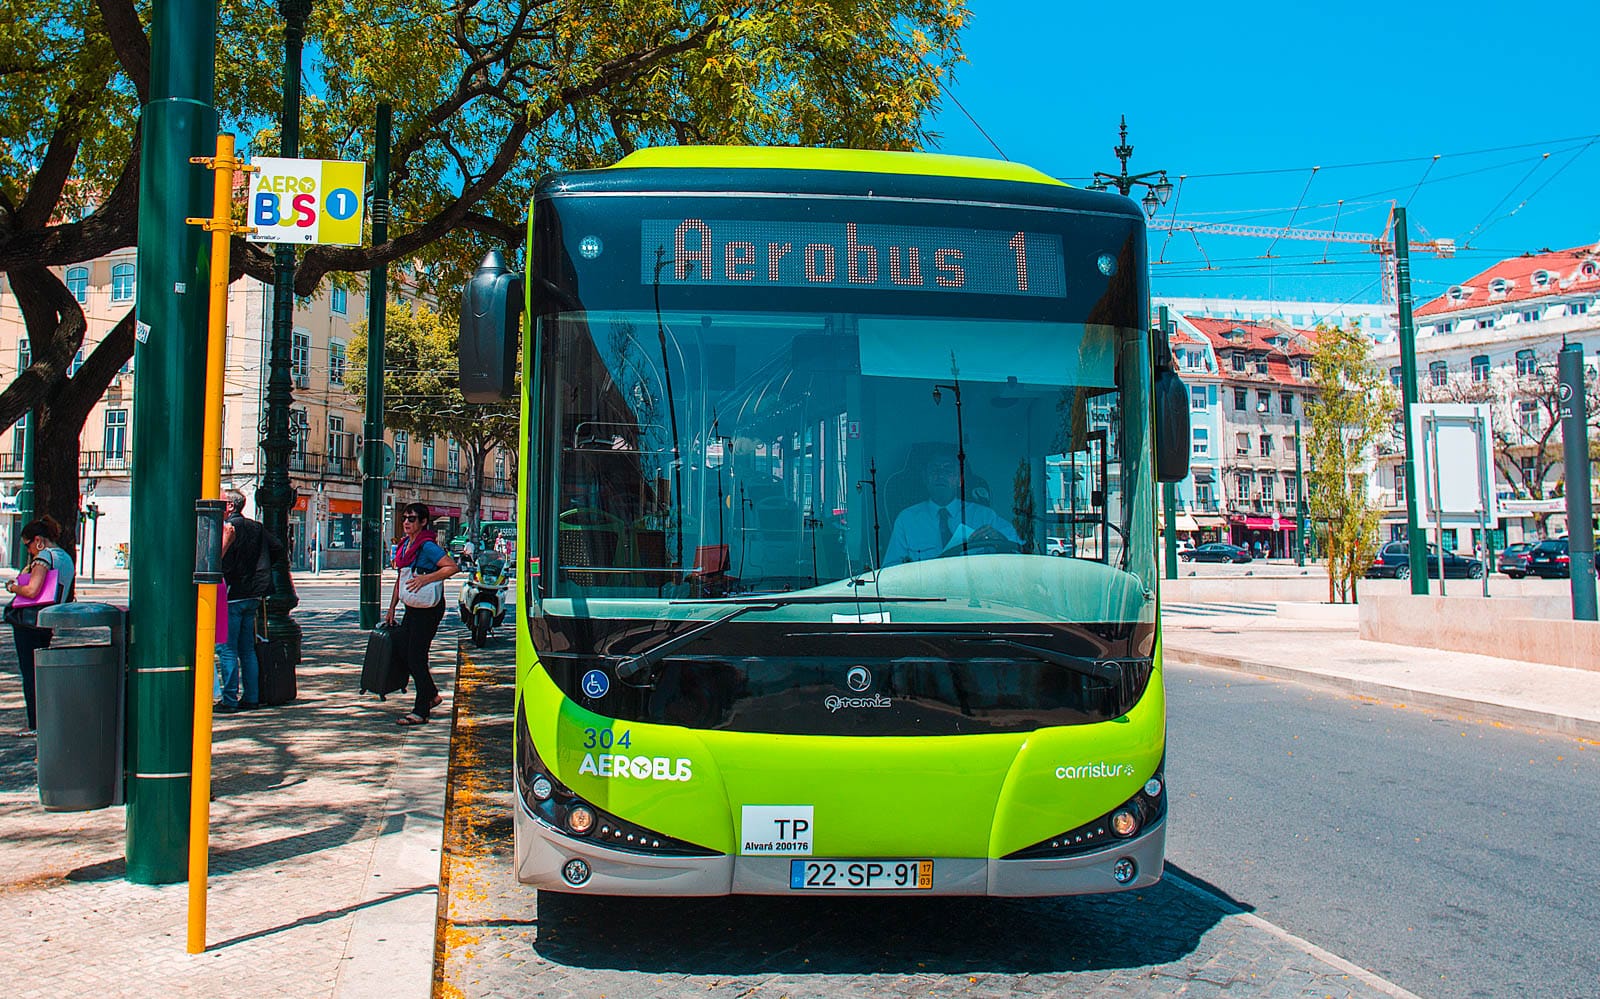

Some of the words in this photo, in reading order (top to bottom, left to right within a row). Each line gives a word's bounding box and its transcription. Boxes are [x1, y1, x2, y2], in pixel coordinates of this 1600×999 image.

[256, 175, 316, 193] AERO
[254, 192, 316, 228] BUS
[336, 193, 347, 216] 1
[674, 218, 966, 287] Aerobus
[1008, 230, 1029, 291] 1
[583, 727, 632, 749] 304
[578, 752, 693, 782] AEROBUS
[1055, 761, 1123, 779] carristur
[774, 819, 809, 840] TP
[745, 842, 773, 851] Alvará
[775, 842, 809, 851] 200176
[923, 864, 931, 872] 17
